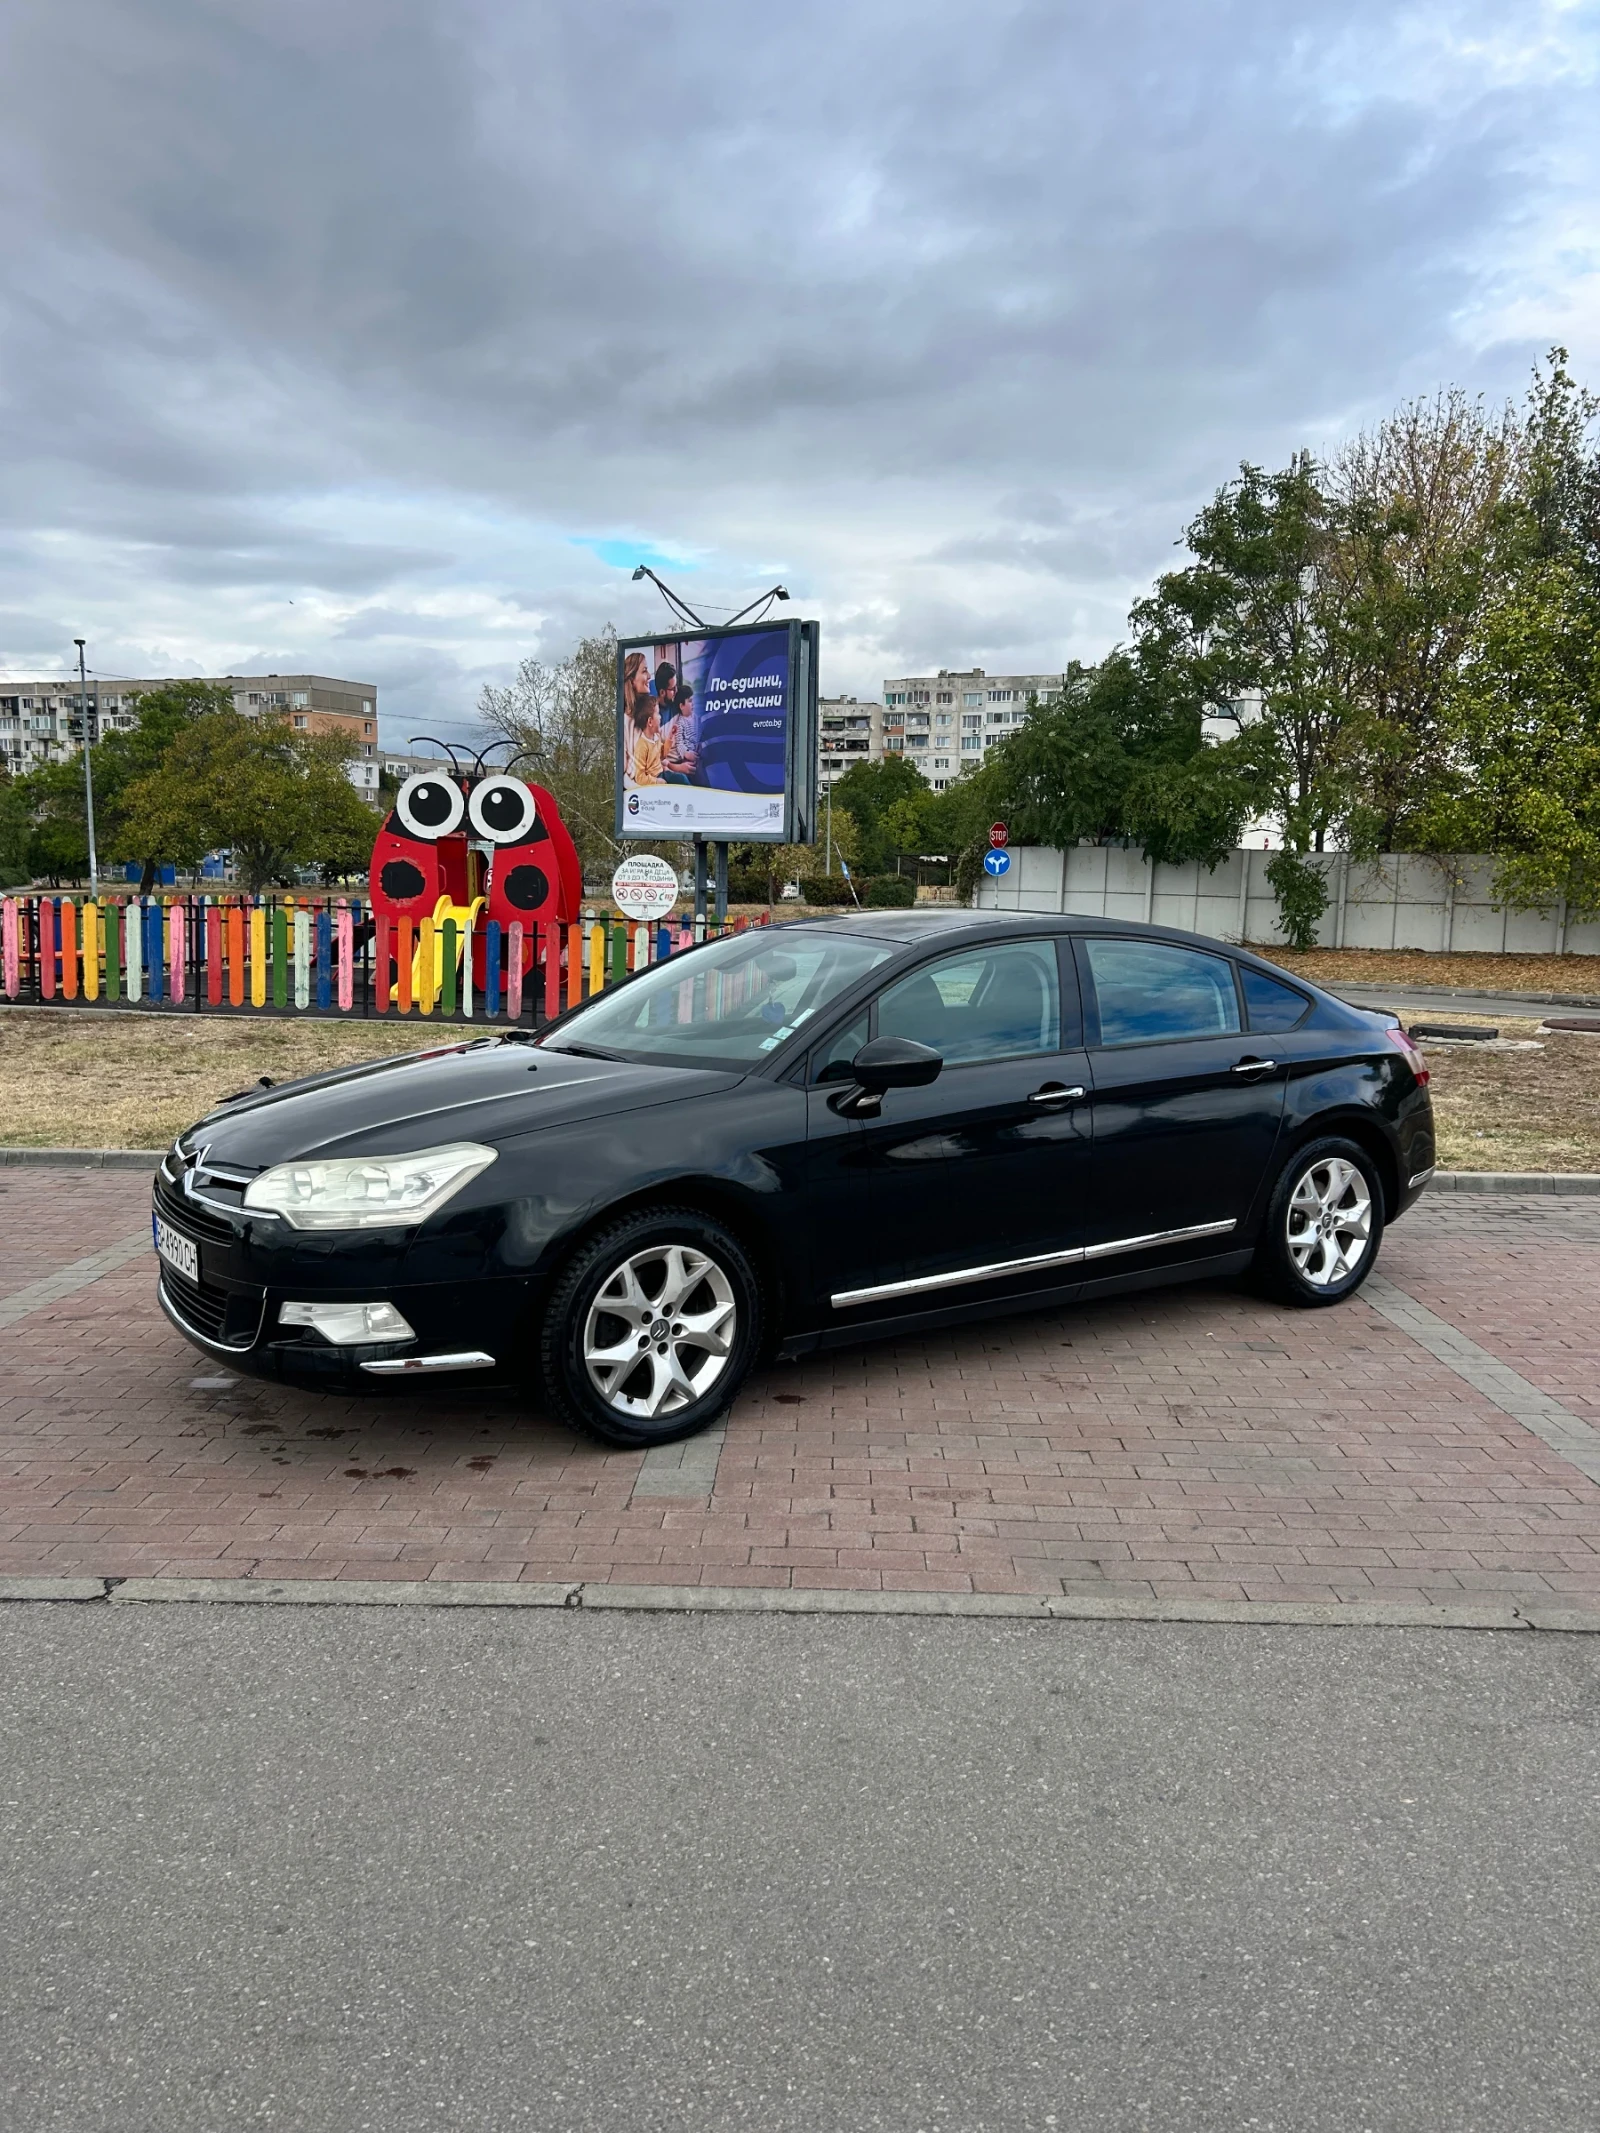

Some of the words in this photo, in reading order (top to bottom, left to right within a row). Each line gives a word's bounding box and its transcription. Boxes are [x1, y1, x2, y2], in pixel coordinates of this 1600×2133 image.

[710, 674, 783, 693] По-единни,
[705, 694, 783, 714] по-успешни
[991, 830, 1006, 841] STOP
[712, 1232, 747, 1273] Vector
